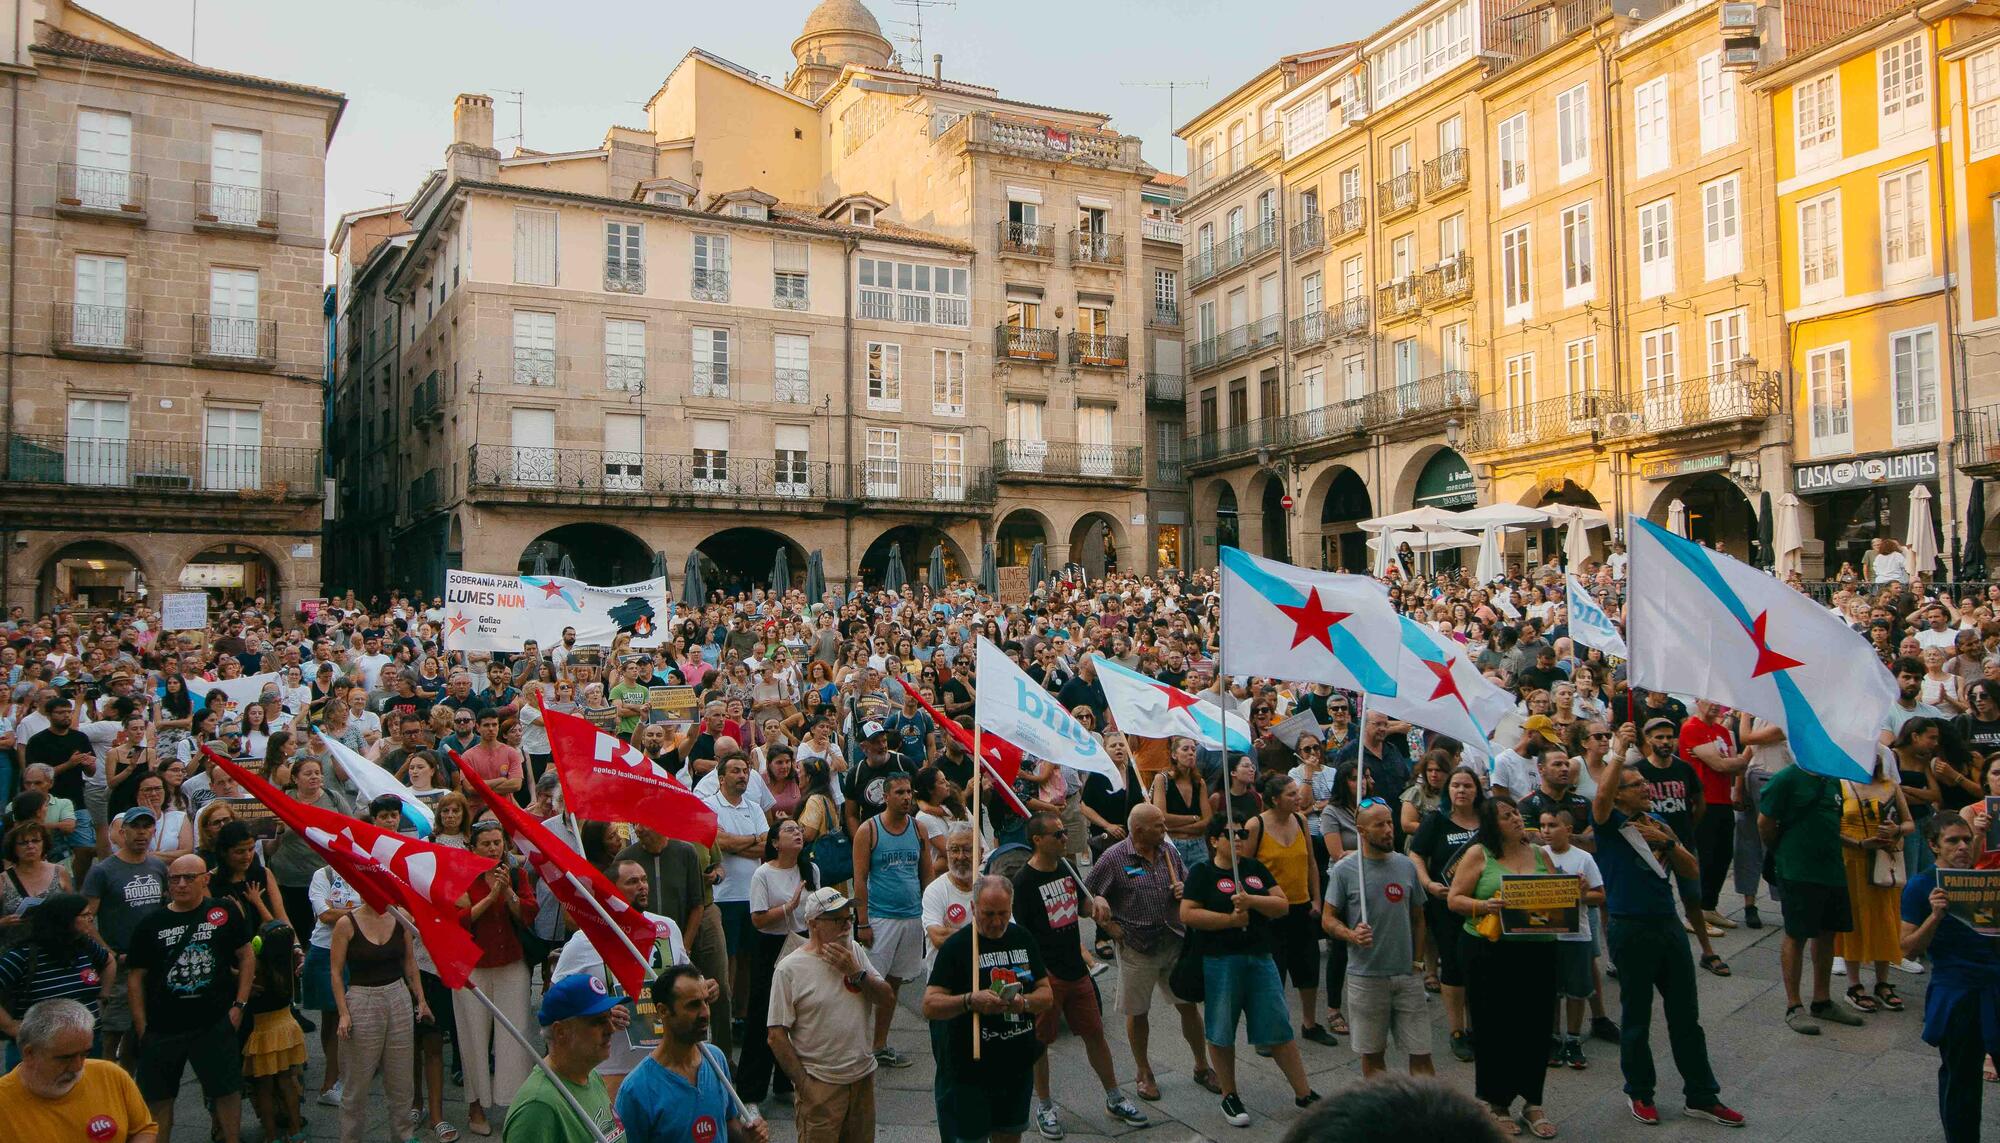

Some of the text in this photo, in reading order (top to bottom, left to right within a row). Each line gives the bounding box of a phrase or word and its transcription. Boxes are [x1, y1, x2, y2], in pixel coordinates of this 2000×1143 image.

[1663, 461, 1679, 474] Bar
[1683, 455, 1724, 472] MUNDIAL
[1797, 452, 1935, 489] CASA DE LOS LENTES
[449, 575, 519, 589] SOBERANÍA PARA
[623, 583, 654, 593] TERRA
[448, 589, 525, 608] LUMES NUN
[478, 615, 501, 624] Galiza
[477, 625, 497, 633] Nova
[1014, 676, 1097, 757] bng
[1649, 797, 1687, 813] NON
[1944, 876, 1985, 887] PARTIDO
[125, 885, 161, 899] ROUBAIX
[157, 925, 185, 940] SOMOS
[165, 931, 212, 947] DE STAS
[978, 951, 1010, 969] ALESTINA
